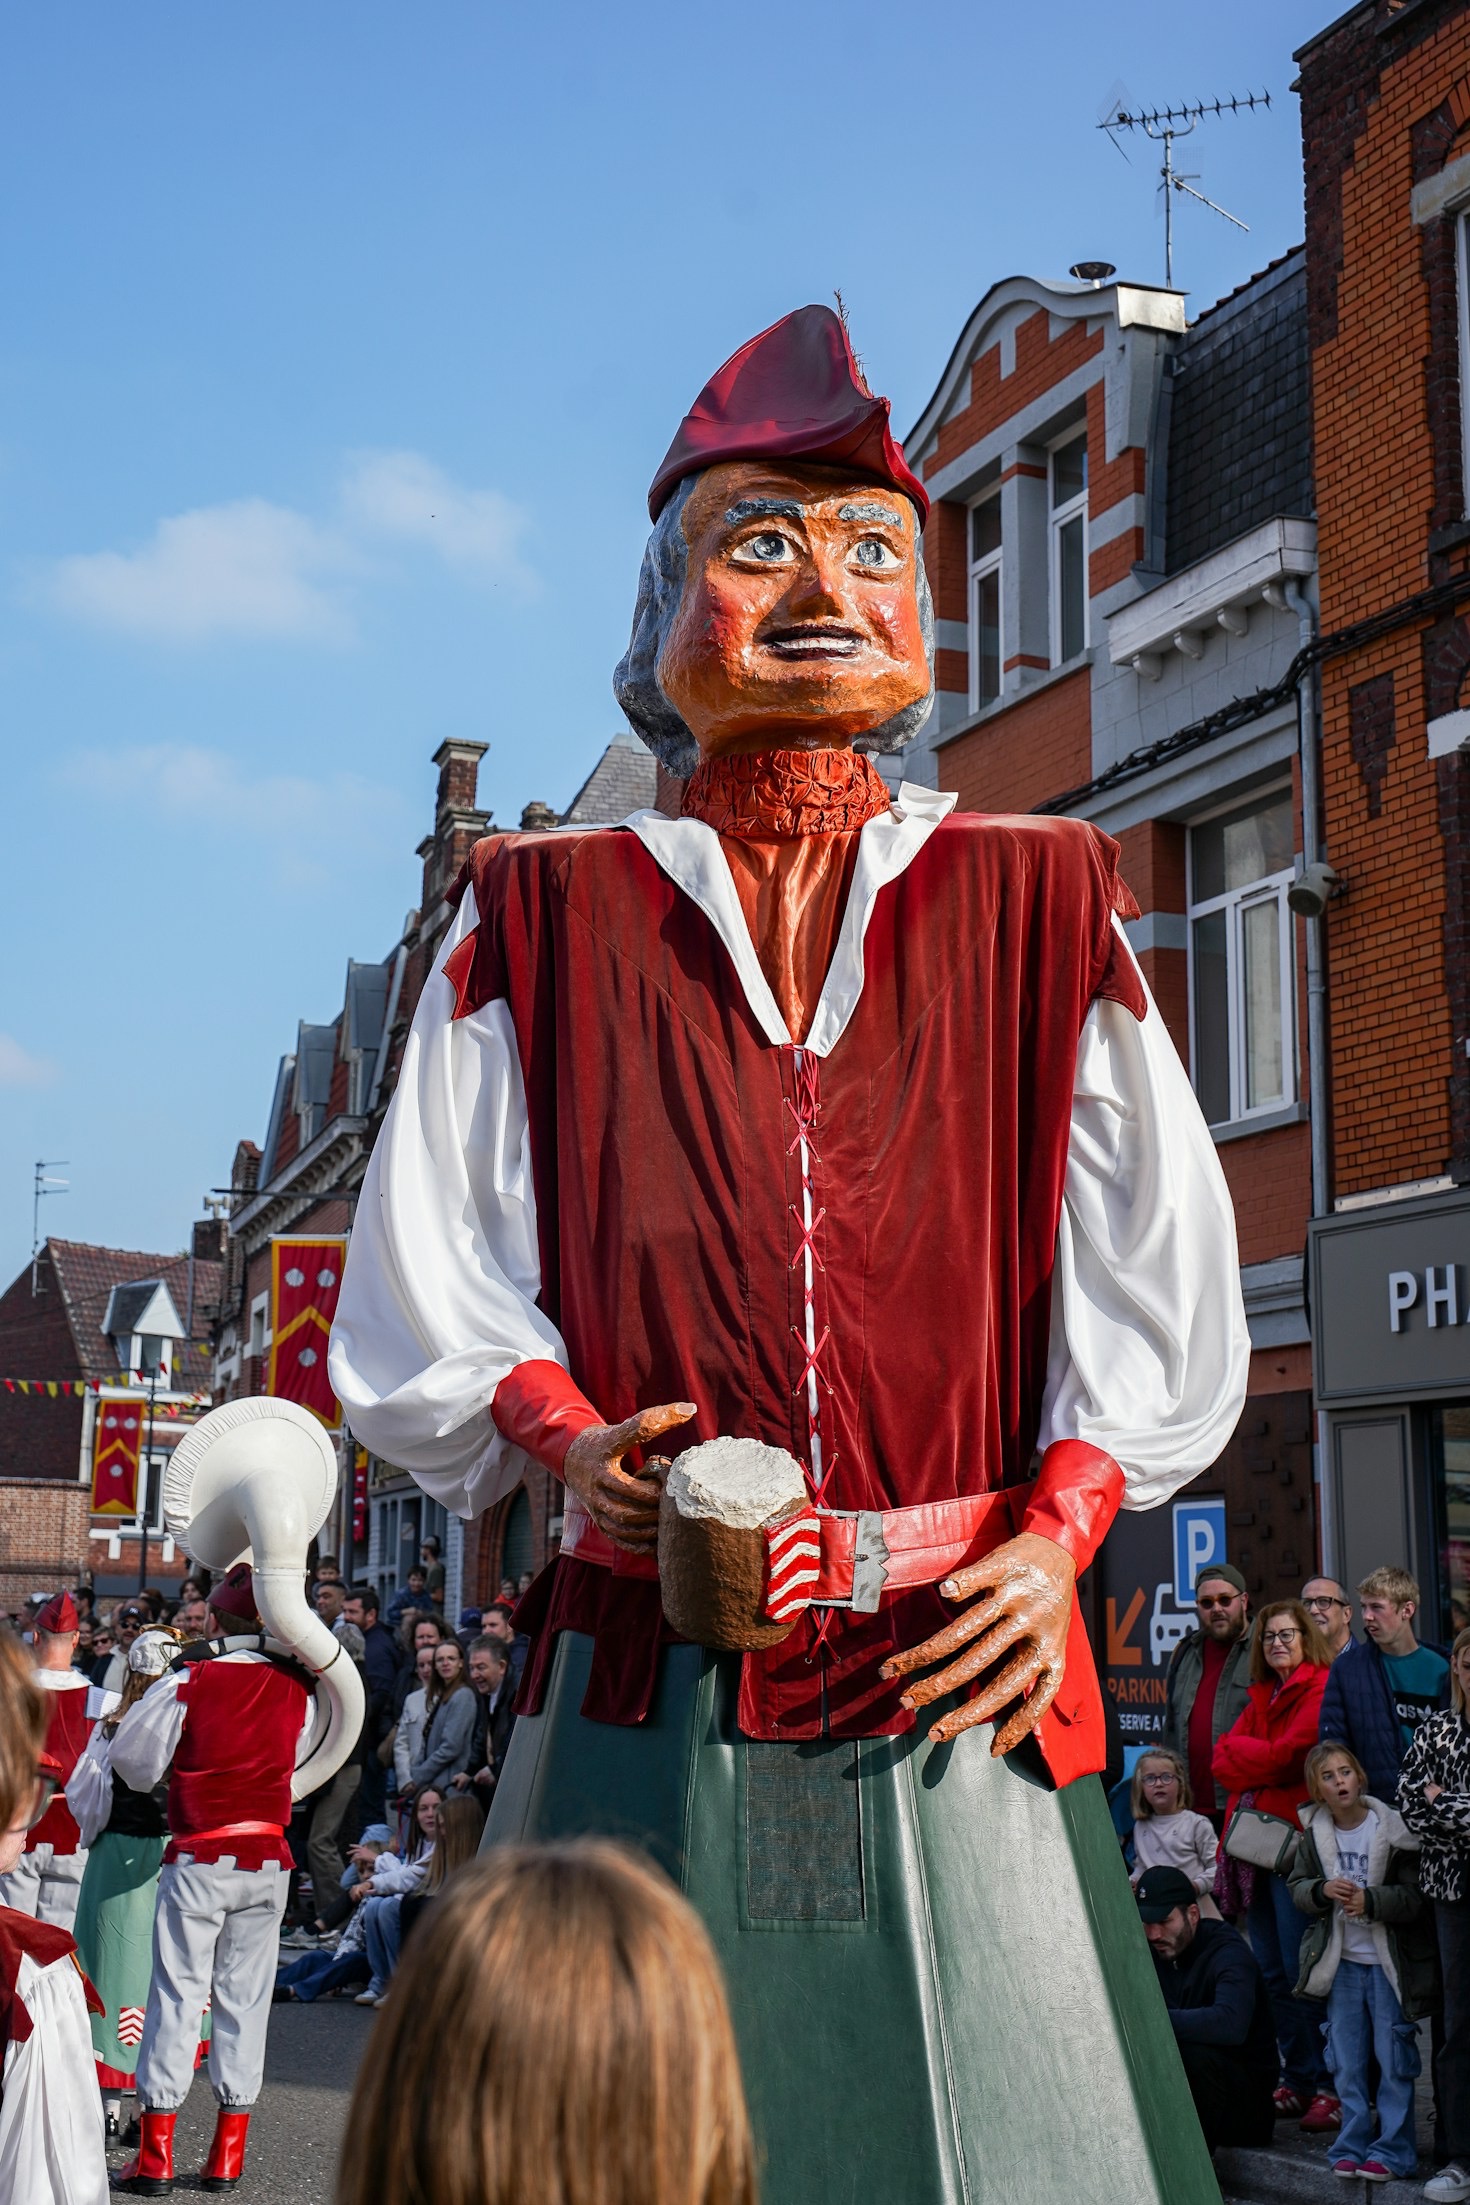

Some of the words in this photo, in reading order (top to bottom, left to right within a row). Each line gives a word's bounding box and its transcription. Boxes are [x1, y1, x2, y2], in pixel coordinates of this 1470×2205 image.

[1388, 1263, 1470, 1333] PH
[1187, 1519, 1215, 1590] P
[1152, 1715, 1161, 1731] A
